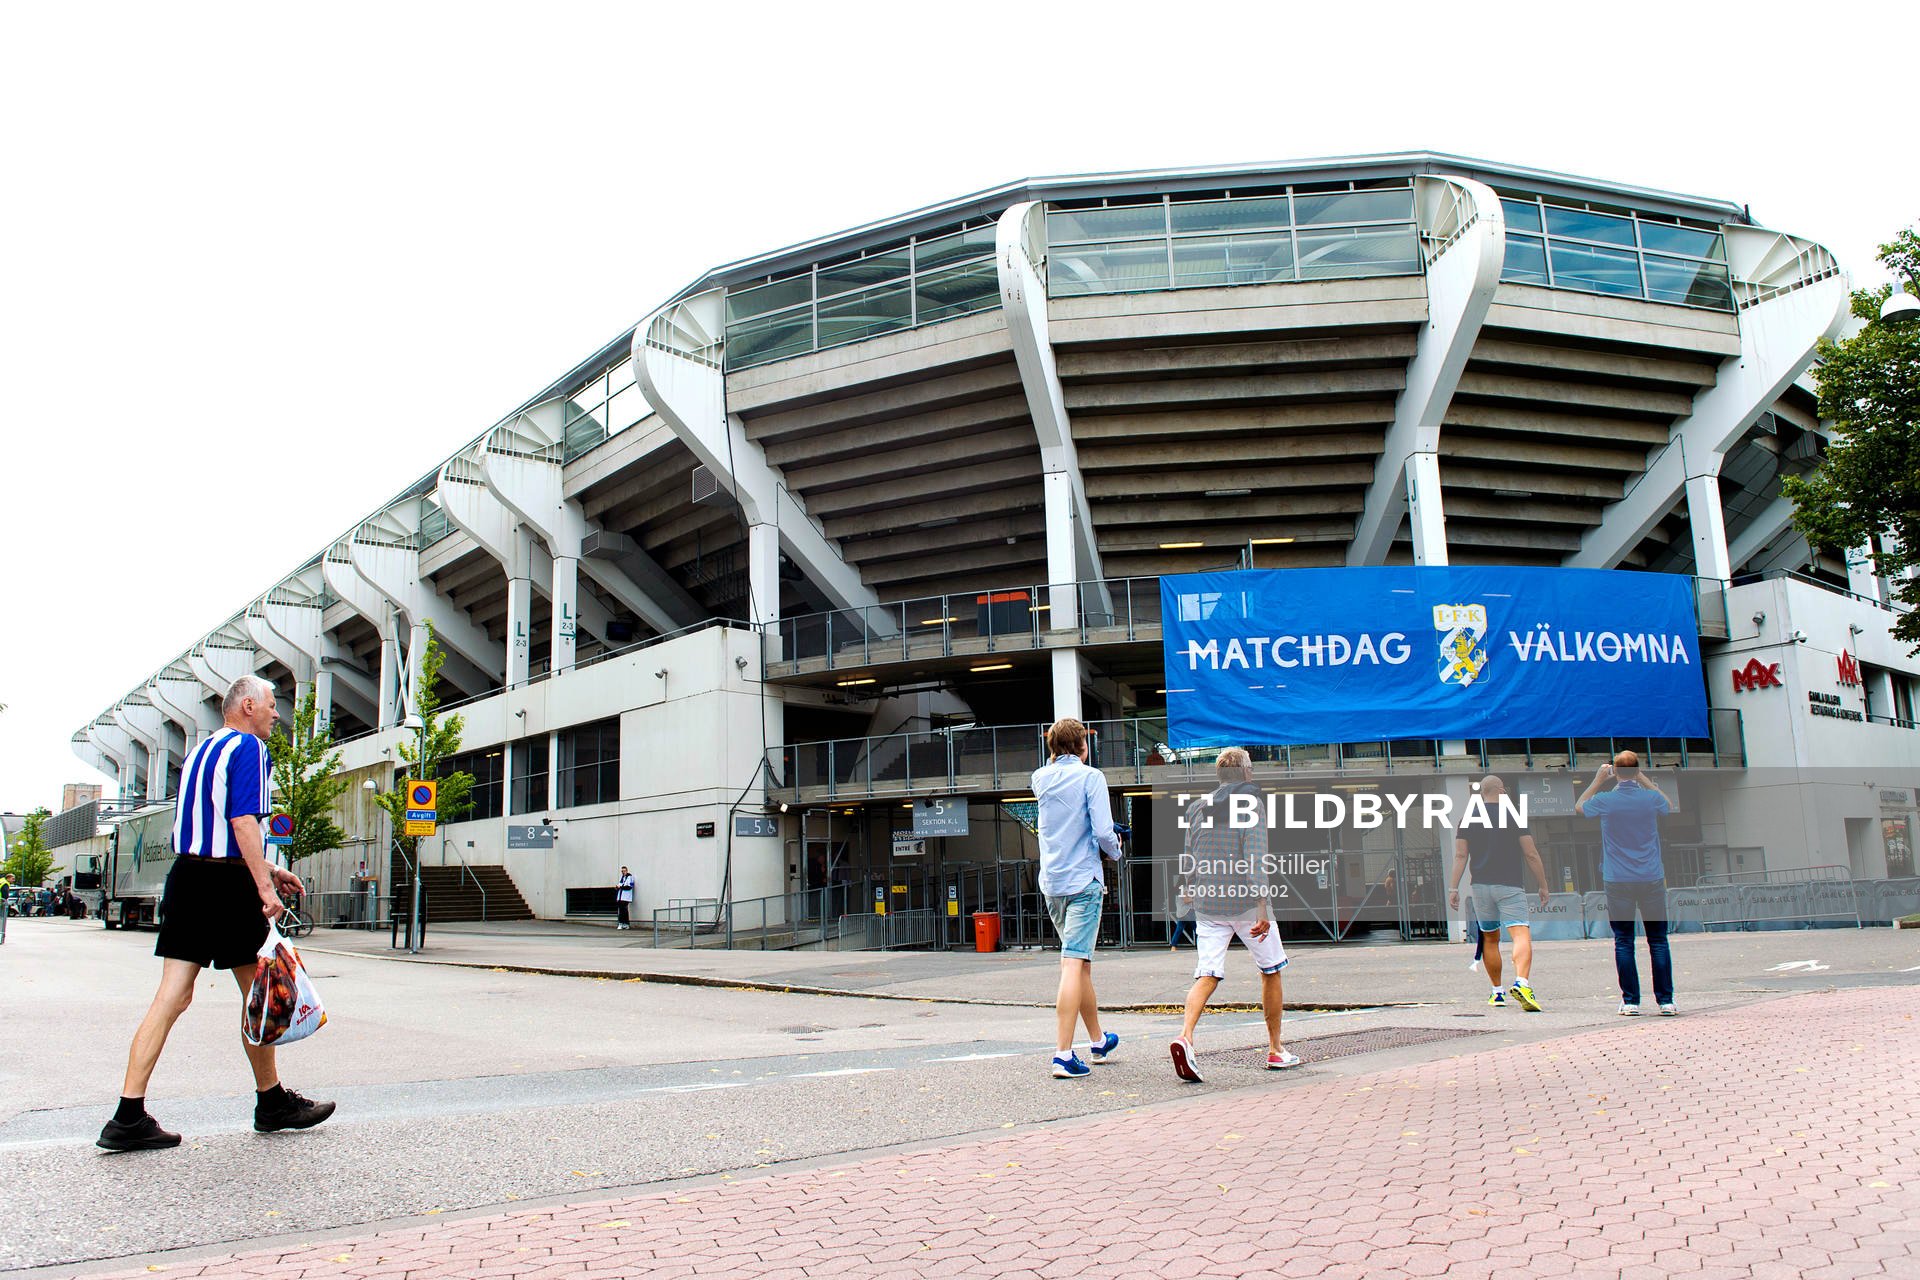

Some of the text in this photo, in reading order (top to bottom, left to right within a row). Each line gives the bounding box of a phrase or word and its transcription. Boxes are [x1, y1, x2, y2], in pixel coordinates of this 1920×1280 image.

[1848, 549, 1864, 559] 2-3
[563, 602, 573, 620] L
[517, 621, 526, 637] L
[562, 622, 574, 630] 2-3
[515, 639, 527, 647] 2-3
[1187, 622, 1690, 670] MATCHDAG VÄLKOMNA
[1732, 657, 1783, 693] MAX
[320, 709, 327, 720] L
[1542, 777, 1551, 793] 5
[935, 799, 944, 815] 5
[411, 812, 431, 820] Avgift
[921, 818, 946, 826] SEKTION
[527, 826, 536, 840] 8
[753, 819, 761, 834] 5
[1536, 905, 1568, 914] ULLEVI
